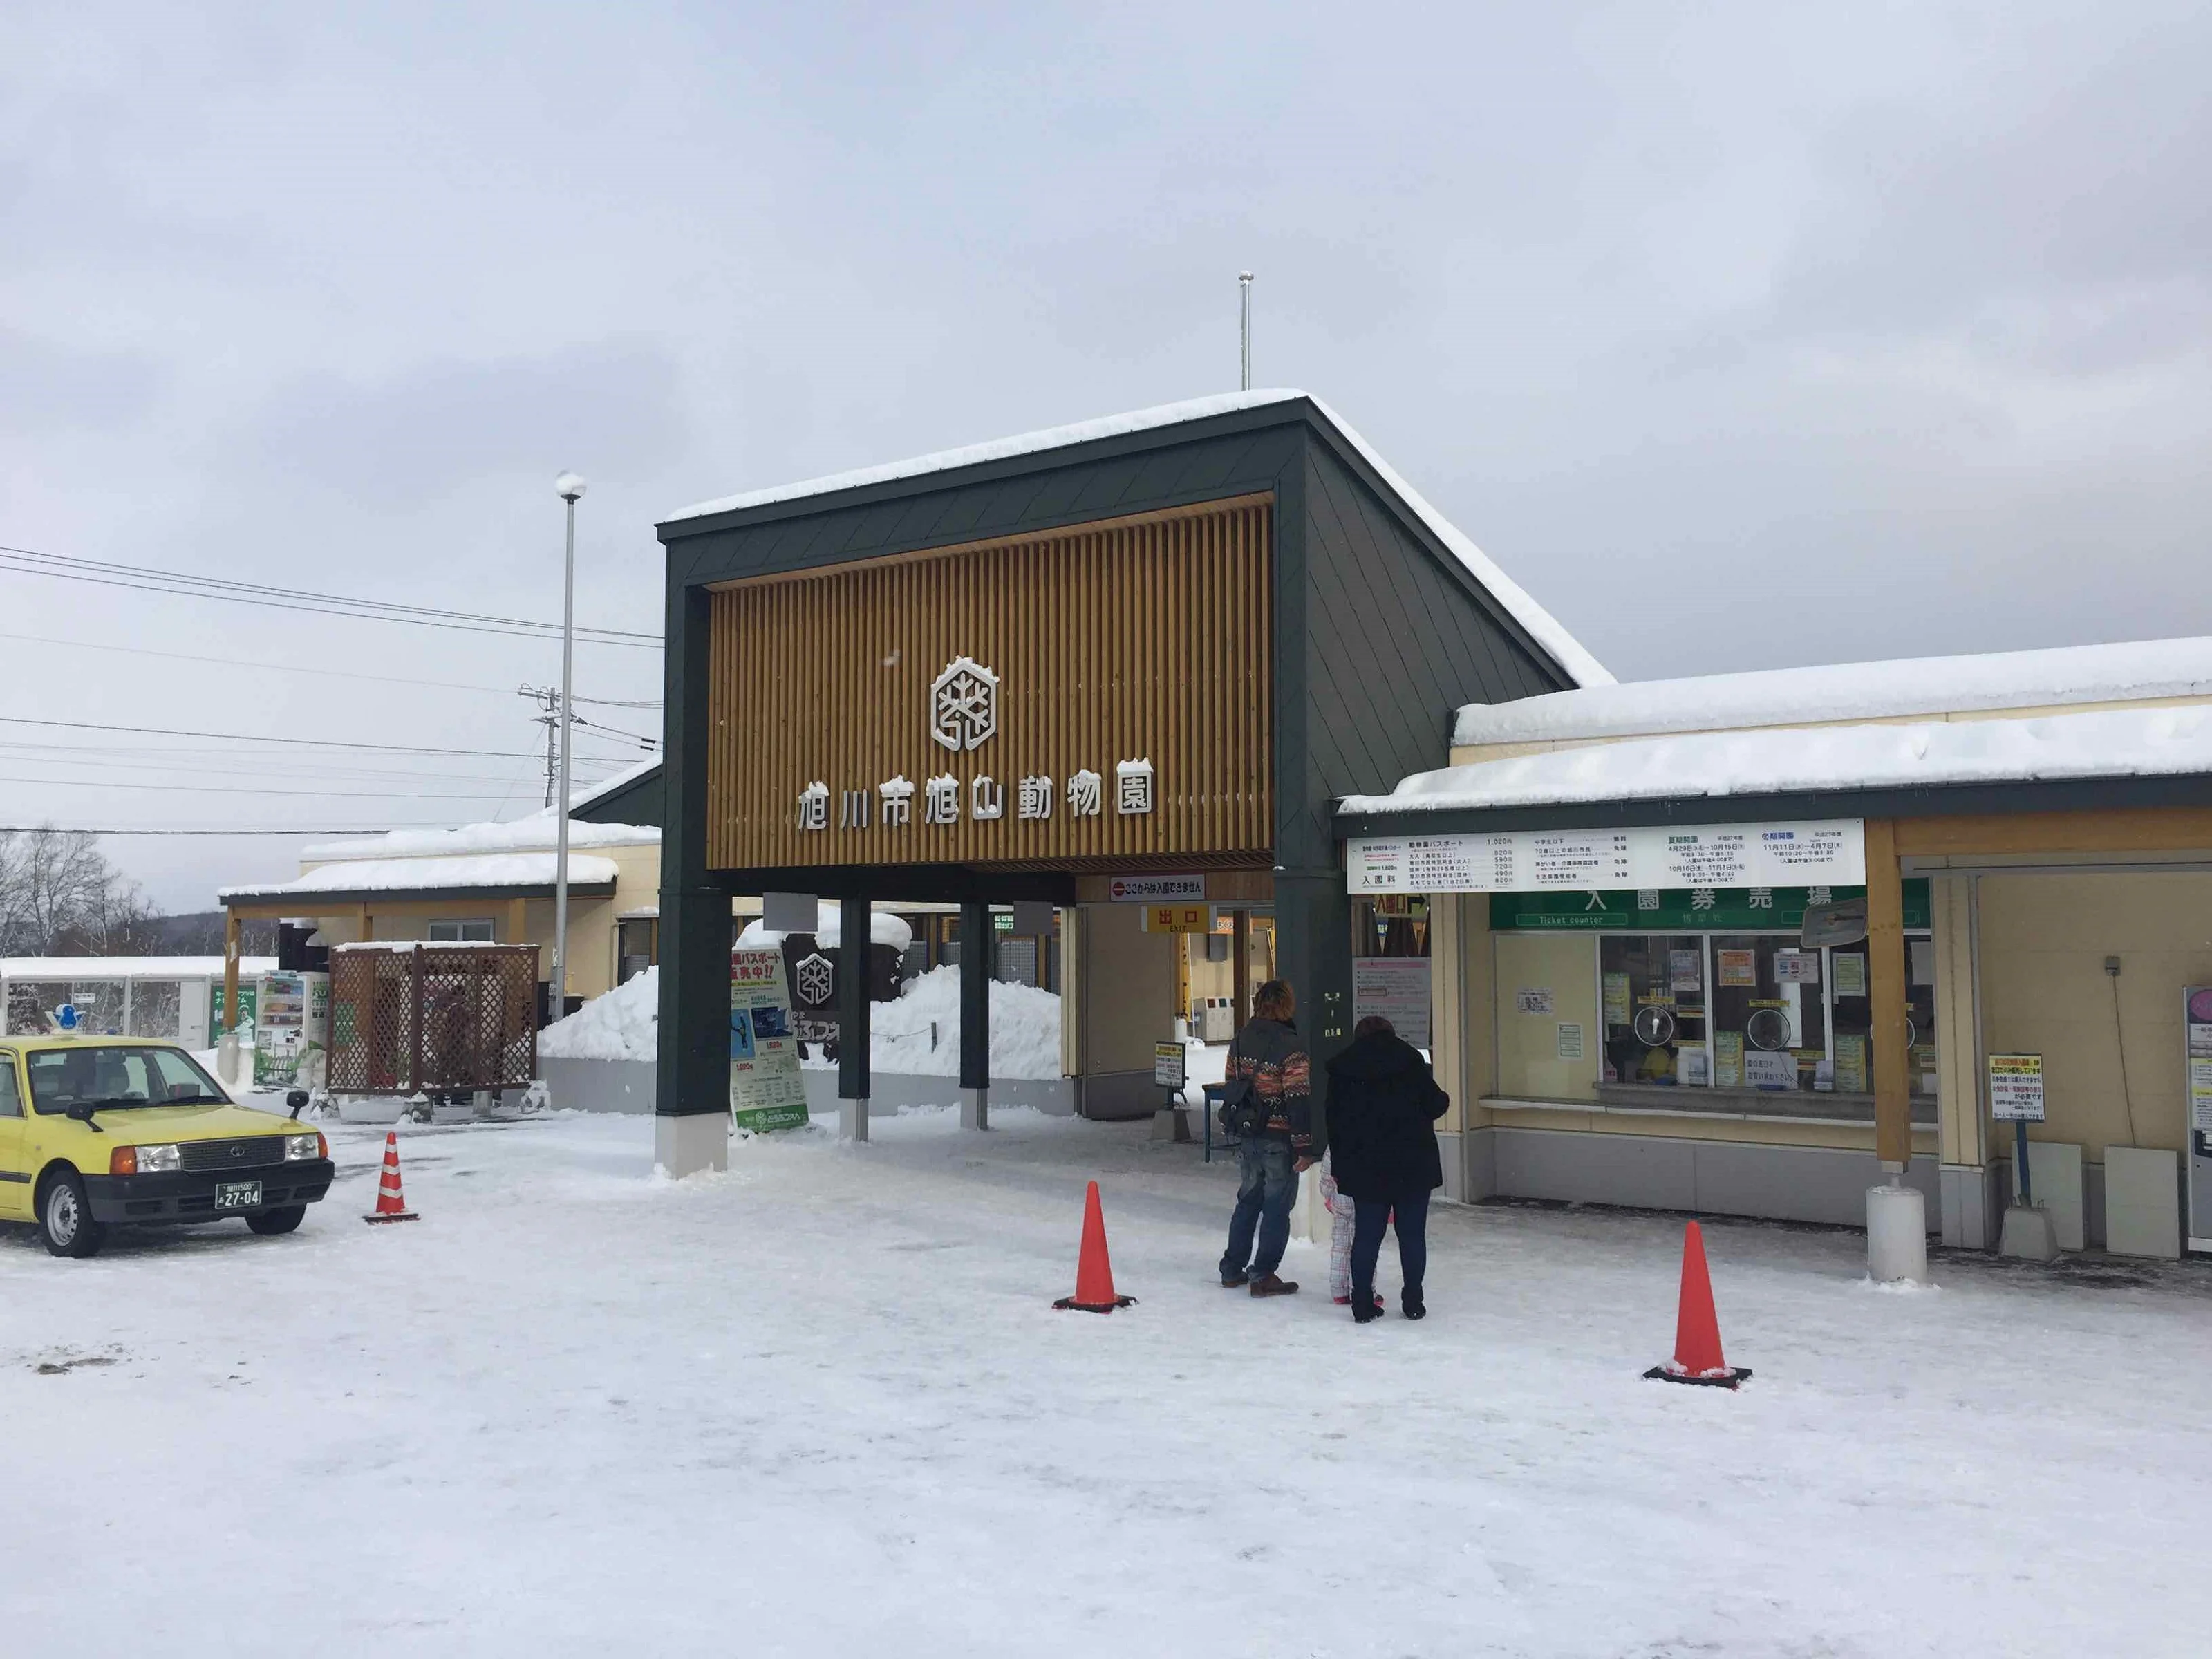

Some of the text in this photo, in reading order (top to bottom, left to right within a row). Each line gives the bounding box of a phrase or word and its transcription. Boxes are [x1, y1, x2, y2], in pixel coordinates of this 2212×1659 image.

[798, 766, 1152, 830] 旭川市旭山動物園
[1362, 875, 1395, 884] 入園料
[1125, 882, 1201, 894] ここからは入園できません
[1585, 887, 1832, 910] 入園券売場
[1159, 910, 1197, 924] 出口
[1570, 916, 1603, 924] counter
[225, 1190, 259, 1206] 27-04
